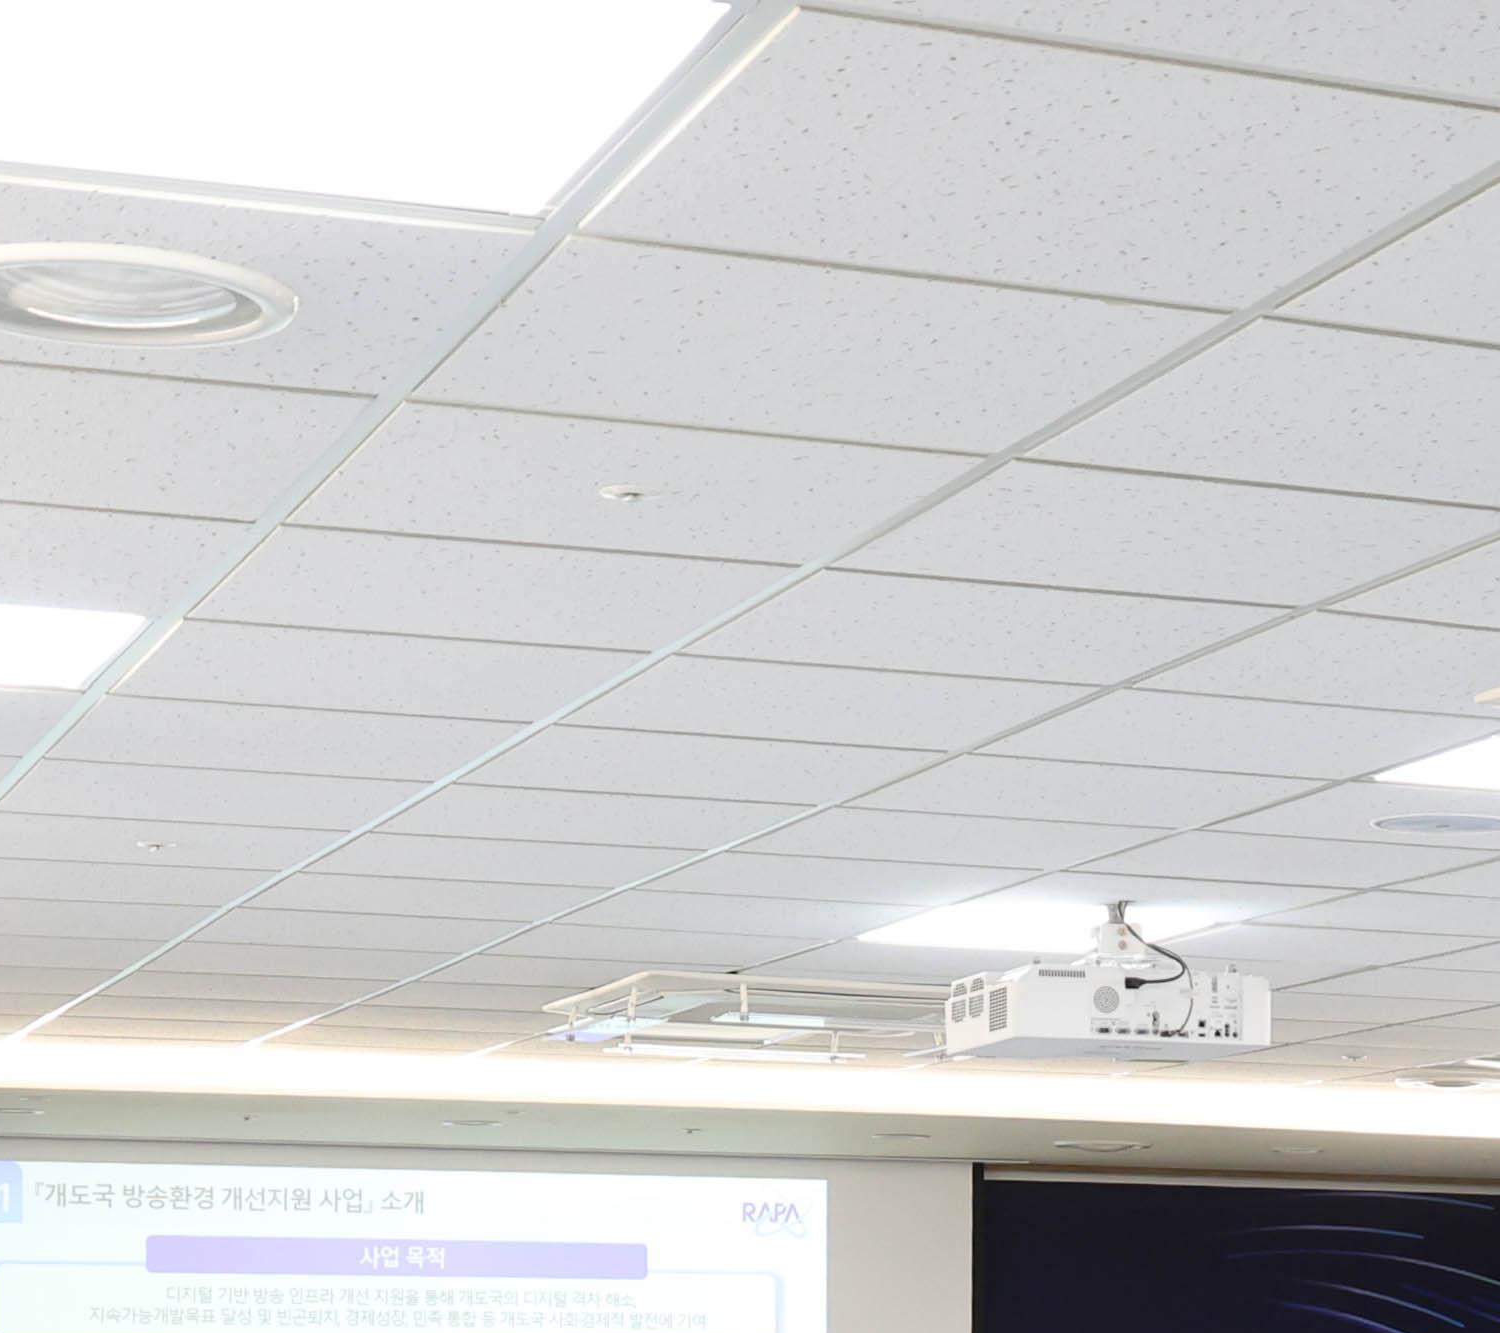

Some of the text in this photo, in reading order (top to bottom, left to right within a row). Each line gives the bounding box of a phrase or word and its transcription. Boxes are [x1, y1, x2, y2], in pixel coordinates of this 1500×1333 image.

[35, 1181, 425, 1215] 『개도국 방송환경 개선지원 사업』 소개
[742, 1202, 803, 1223] RAPA
[359, 1246, 446, 1270] 사업 목적
